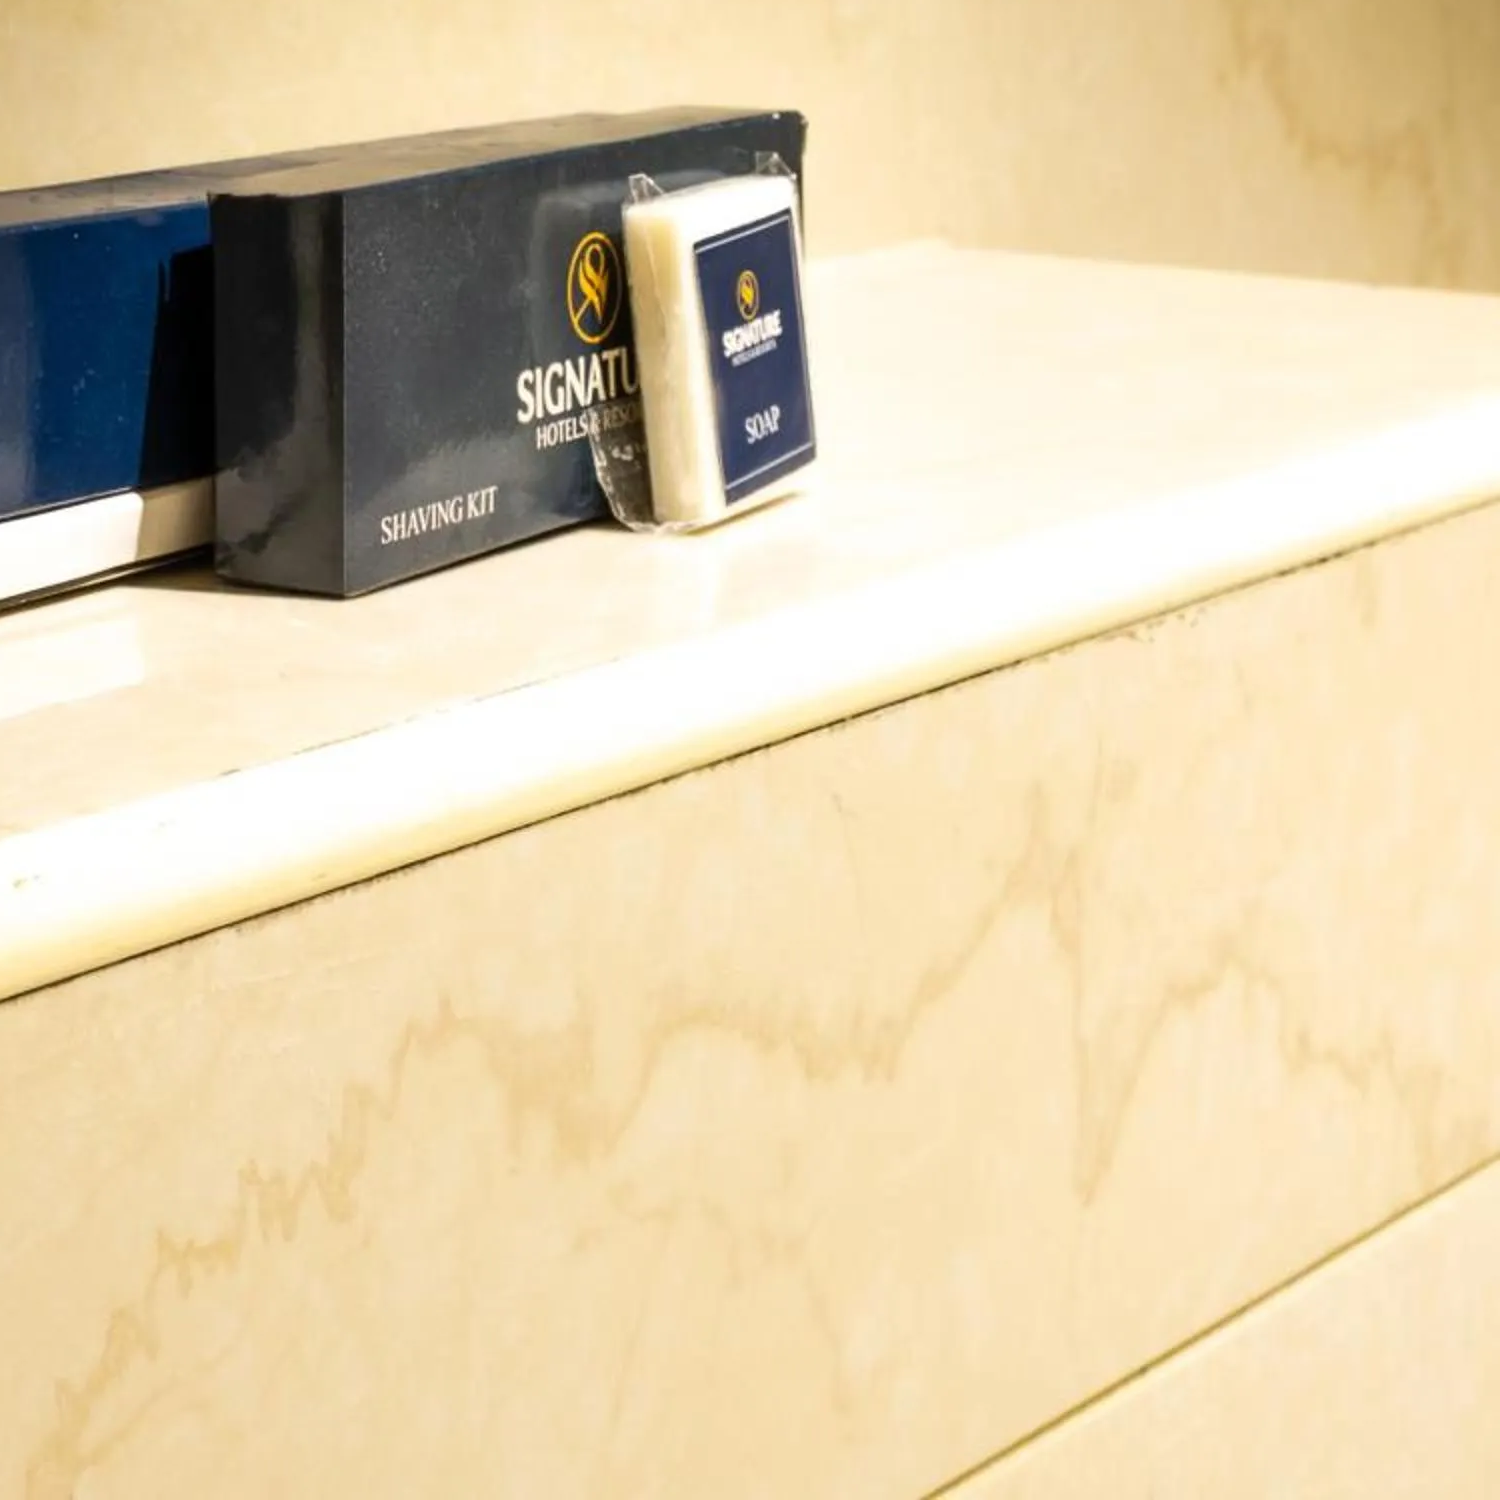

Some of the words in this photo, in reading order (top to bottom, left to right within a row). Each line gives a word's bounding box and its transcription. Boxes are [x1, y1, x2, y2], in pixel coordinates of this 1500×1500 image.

[536, 409, 590, 450] HOTELS
[745, 404, 780, 444] SOAP
[381, 496, 463, 545] SHAVING
[467, 485, 499, 519] KIT
